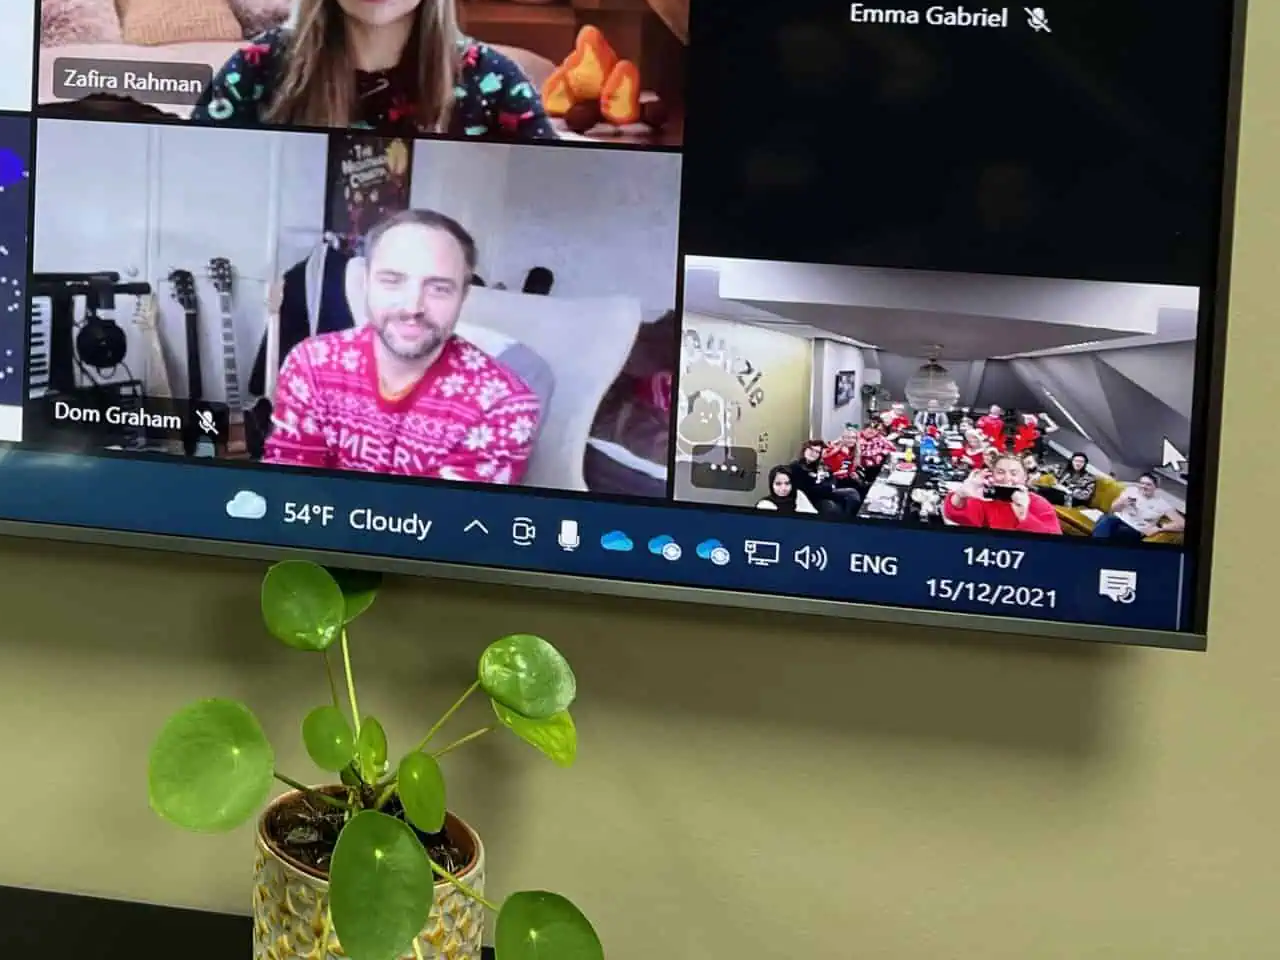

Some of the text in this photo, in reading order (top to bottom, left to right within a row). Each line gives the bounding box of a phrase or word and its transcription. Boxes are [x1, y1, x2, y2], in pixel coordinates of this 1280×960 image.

[850, 2, 1009, 28] Emma Gabriel
[63, 68, 202, 94] Zafira Rahman
[54, 401, 182, 430] Dom Graham
[283, 502, 433, 541] 54°F Cloudy
[849, 553, 899, 576] ENG
[963, 546, 1026, 570] 14:07
[926, 578, 1057, 609] 15/12/2021
